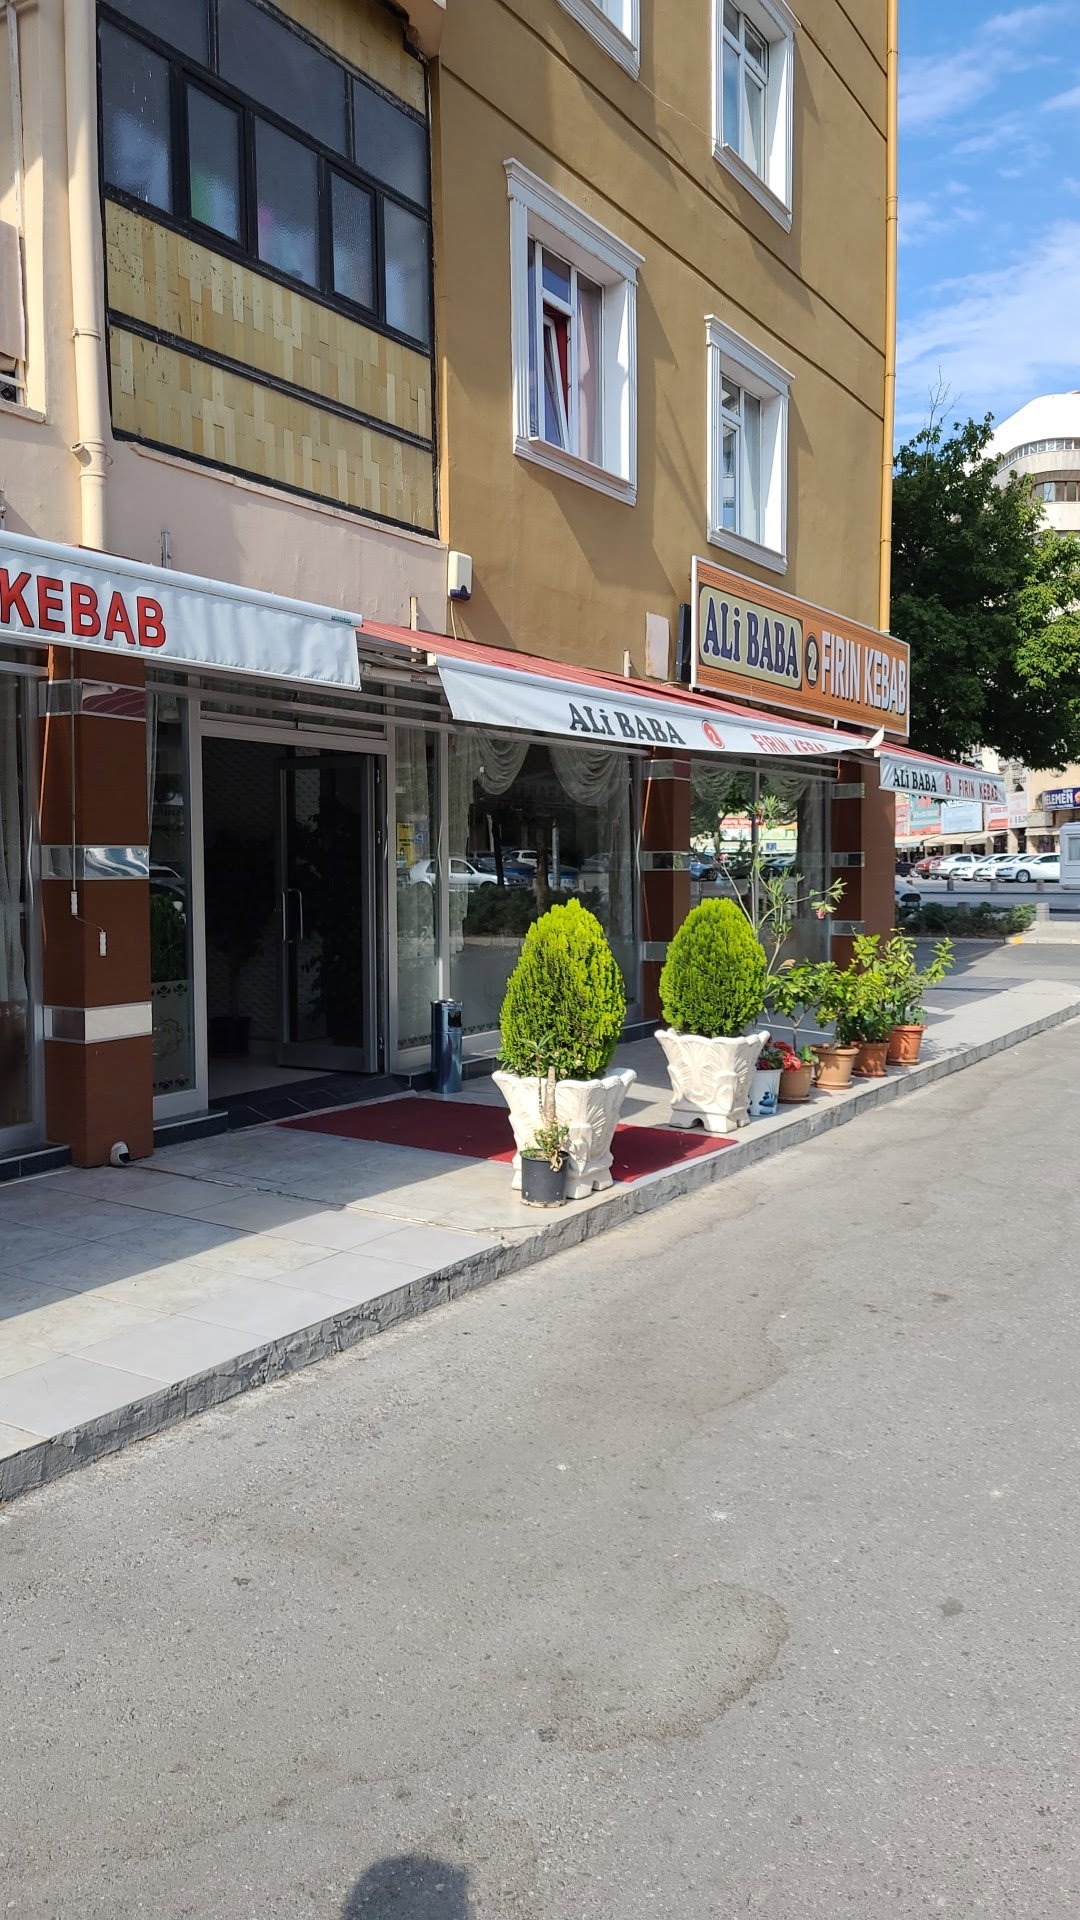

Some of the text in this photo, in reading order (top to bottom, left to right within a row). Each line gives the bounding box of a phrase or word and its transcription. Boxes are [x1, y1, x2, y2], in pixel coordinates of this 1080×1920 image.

[0, 568, 166, 648] KEBAB
[747, 612, 799, 679] BABA
[807, 642, 817, 681] 2
[821, 630, 906, 715] FIRIN KEBAB
[613, 711, 686, 745] BABA
[750, 733, 791, 753] FIRIN
[912, 771, 937, 792] BABA
[959, 779, 975, 798] FIRIN
[979, 782, 998, 801] KEBAB
